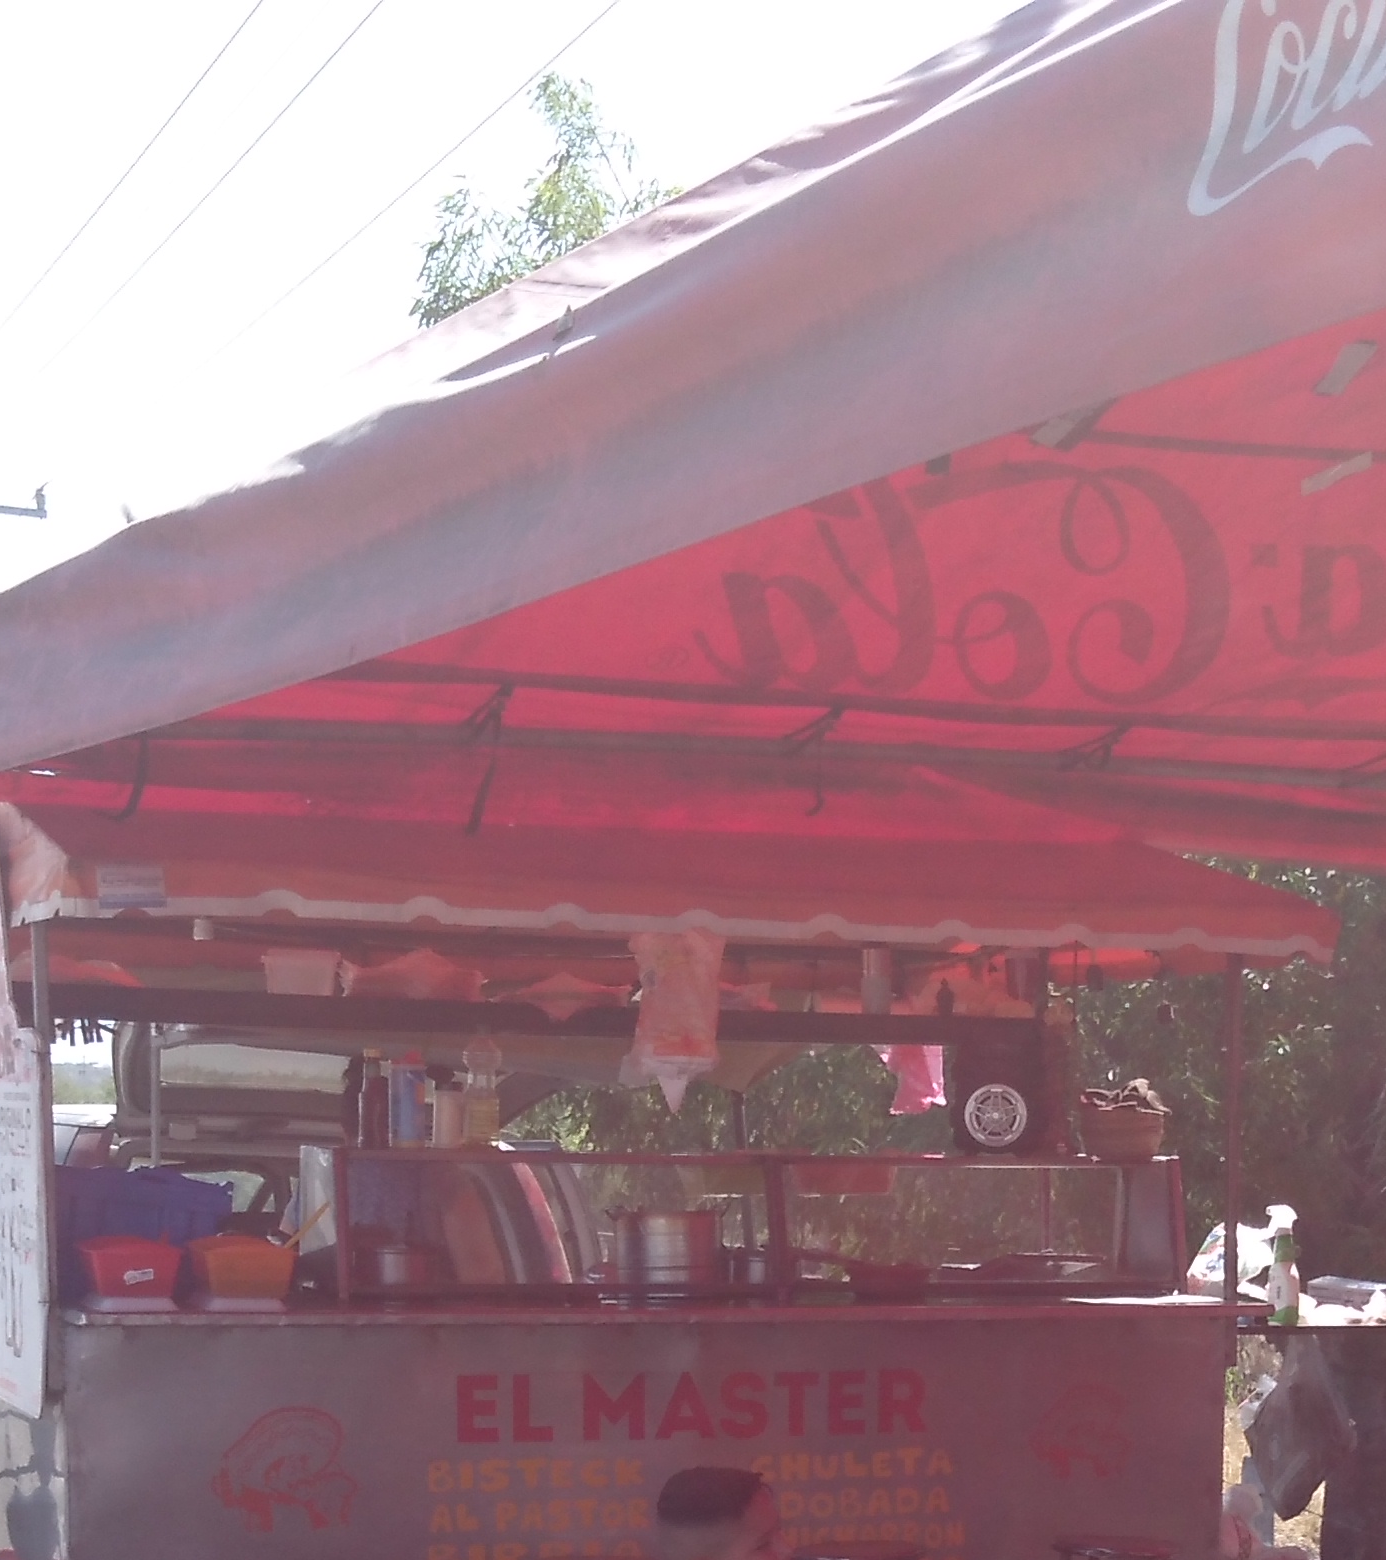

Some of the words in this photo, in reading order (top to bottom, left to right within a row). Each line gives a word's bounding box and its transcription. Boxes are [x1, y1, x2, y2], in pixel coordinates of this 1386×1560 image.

[457, 1374, 553, 1443] EL
[583, 1367, 928, 1442] MASTER
[428, 1457, 644, 1492] BISTECK
[751, 1447, 954, 1482] CHULETA
[430, 1503, 479, 1532] AL
[496, 1498, 651, 1532] PASTOR
[779, 1487, 950, 1519] DOBADA
[780, 1520, 965, 1548] HICHARRON
